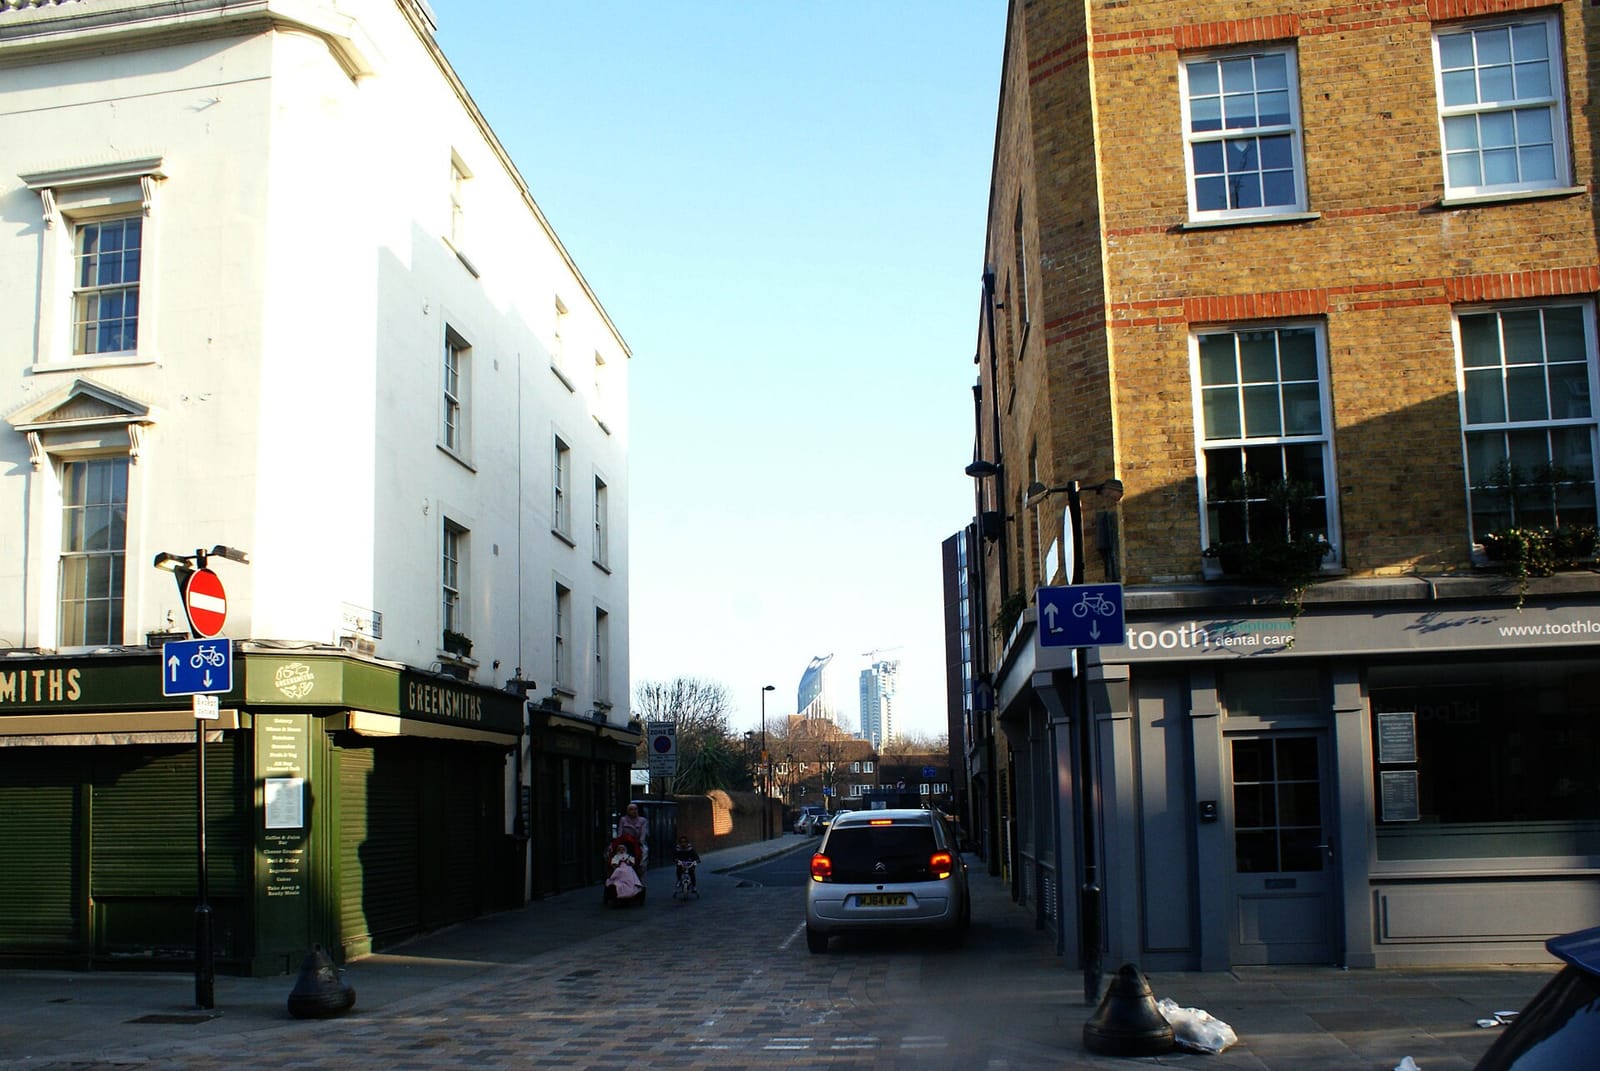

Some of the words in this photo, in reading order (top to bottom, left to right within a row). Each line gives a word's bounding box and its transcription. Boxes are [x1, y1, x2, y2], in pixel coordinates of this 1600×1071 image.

[1126, 622, 1210, 650] tooth
[1215, 632, 1260, 647] dental
[1499, 620, 1600, 637] www.toothlo
[0, 668, 81, 702] MITHS
[408, 680, 482, 722] GREENSMITHS
